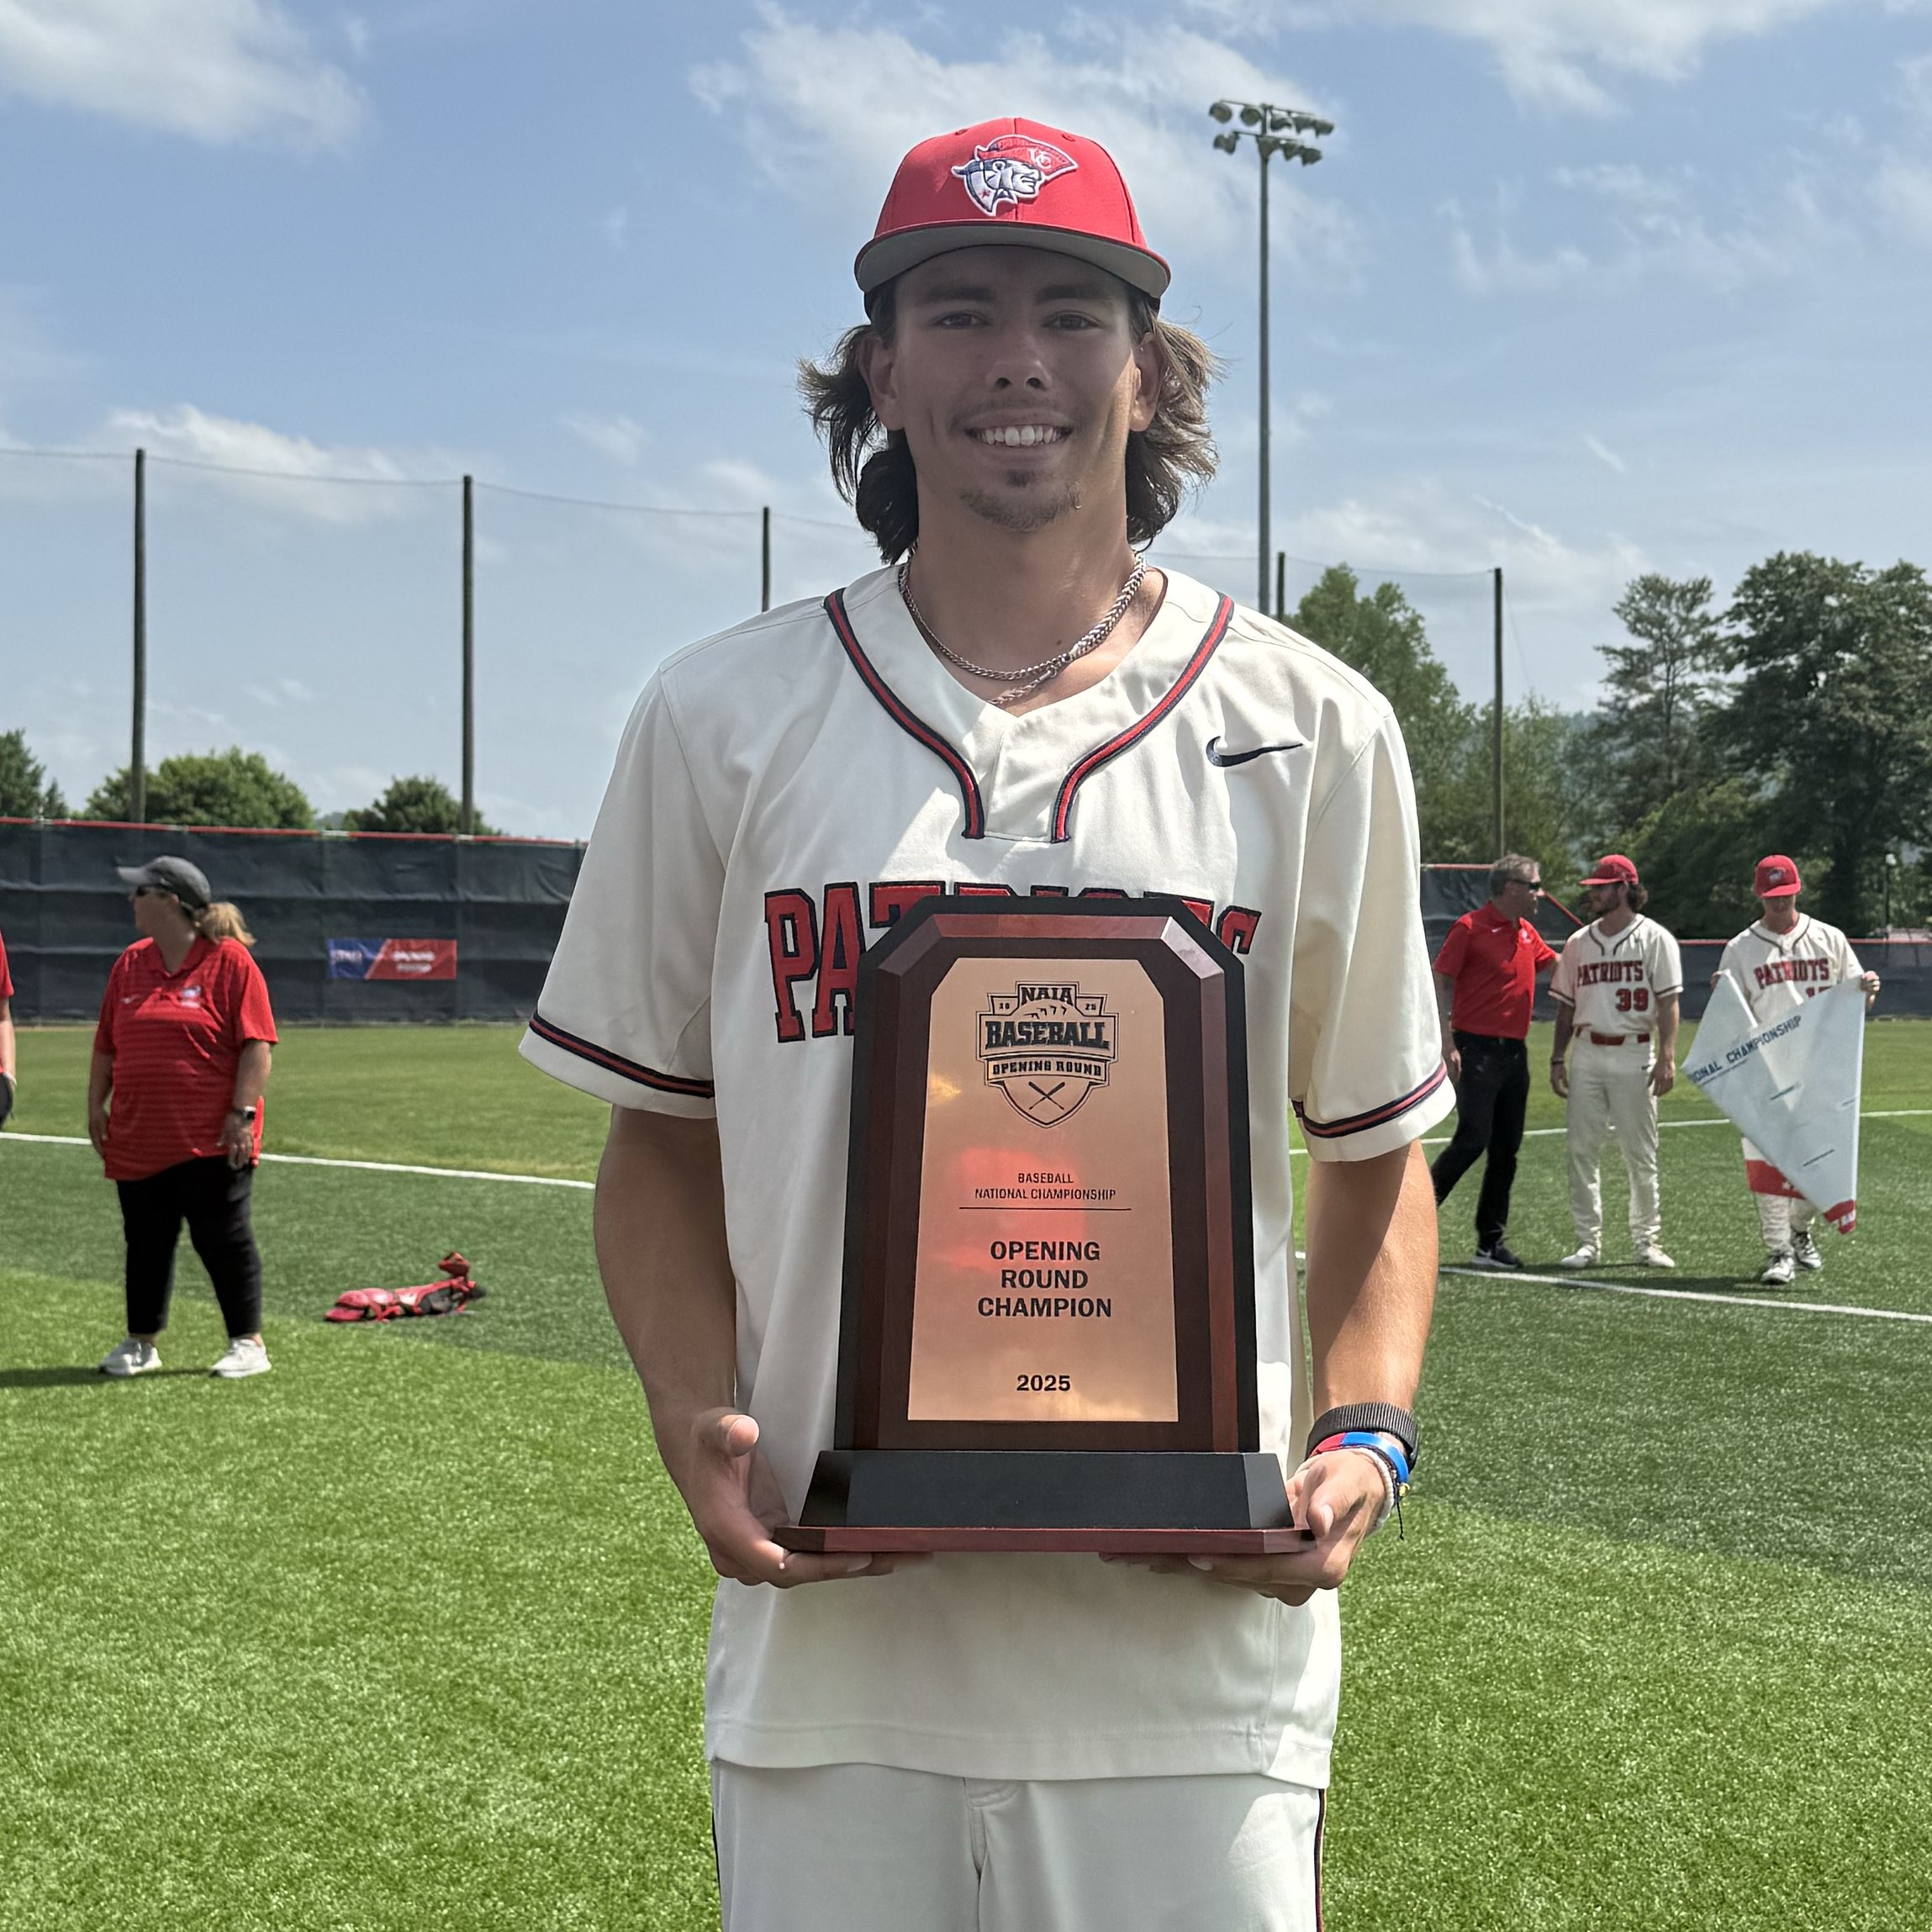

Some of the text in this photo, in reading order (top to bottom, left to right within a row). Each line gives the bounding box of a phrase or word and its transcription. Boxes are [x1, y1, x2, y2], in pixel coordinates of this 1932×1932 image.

[1577, 960, 1644, 988] PATRIOTS
[1753, 958, 1829, 990] PATRIOTS
[1021, 987, 1074, 1005] NAIA
[1615, 988, 1649, 1012] 39
[984, 1021, 1111, 1049] BASEBALL
[1726, 1016, 1802, 1064] CHAMPIONSHIP
[992, 1059, 1101, 1076] OPENING ROUND
[1018, 1173, 1074, 1184] BASEBALL
[974, 1188, 1116, 1201] NATIONAL CHAMPIONSHIP
[990, 1240, 1101, 1261] OPENING
[1000, 1270, 1089, 1289] ROUND
[977, 1296, 1112, 1317] CHAMPION
[1016, 1375, 1071, 1391] 2025
